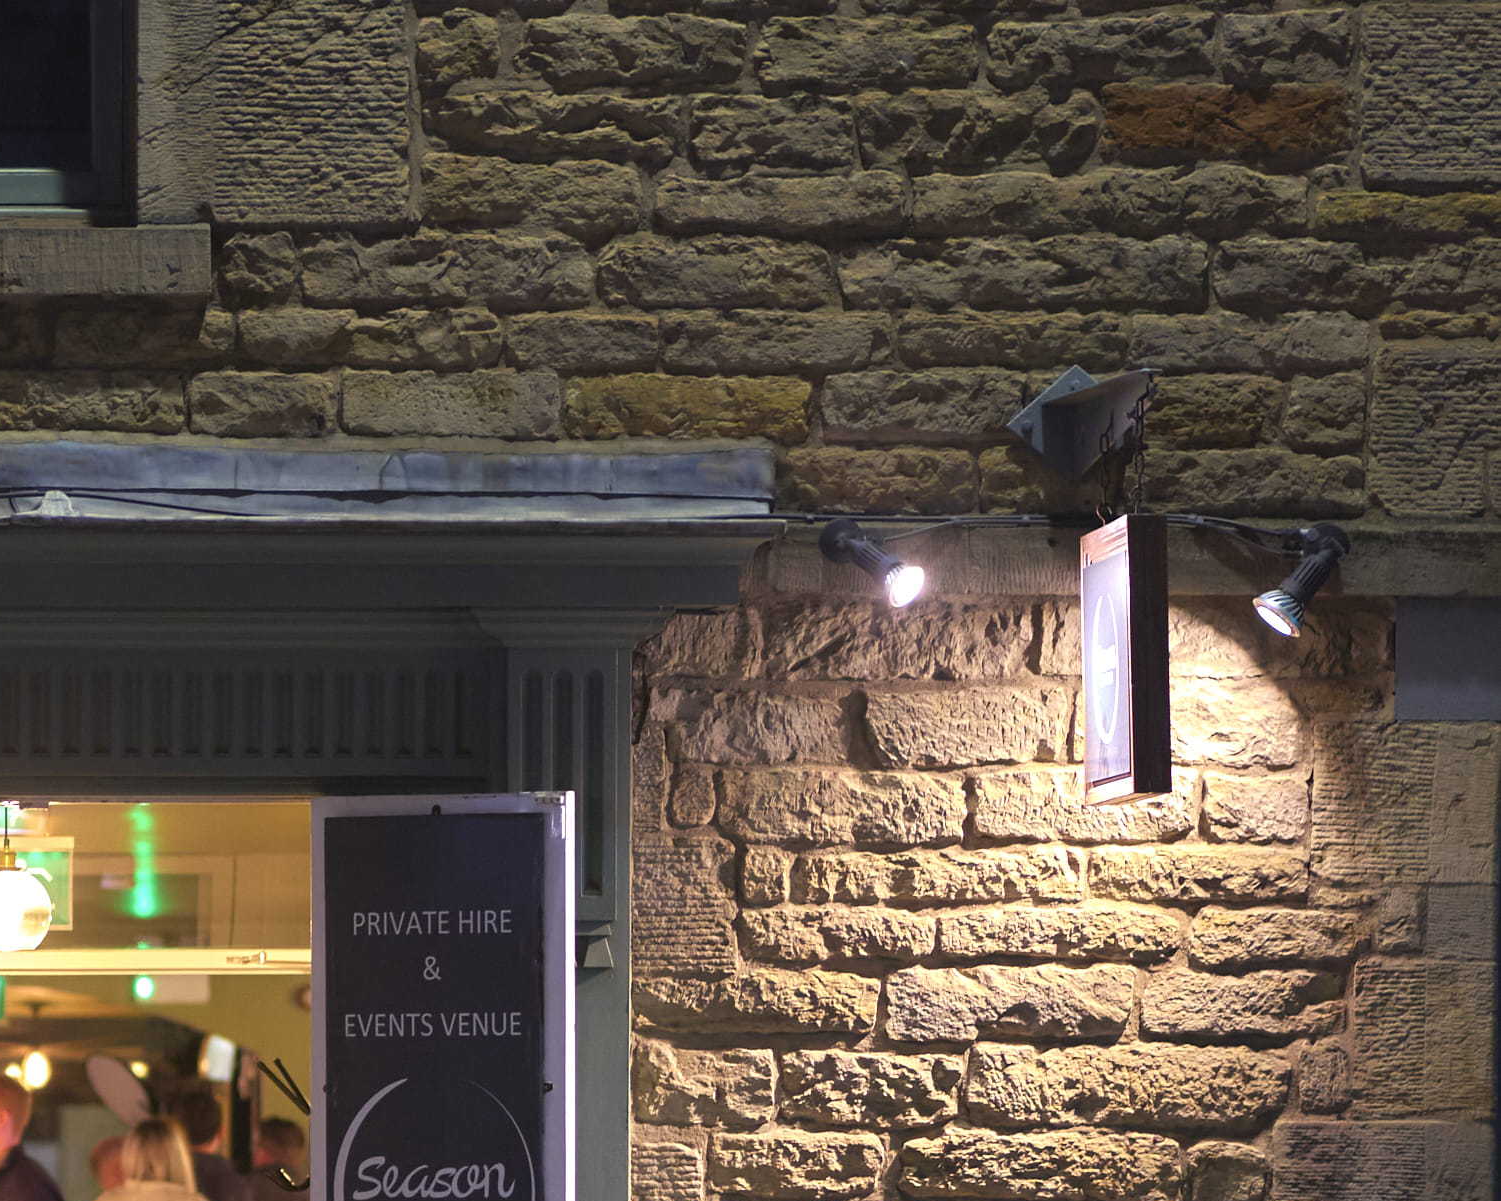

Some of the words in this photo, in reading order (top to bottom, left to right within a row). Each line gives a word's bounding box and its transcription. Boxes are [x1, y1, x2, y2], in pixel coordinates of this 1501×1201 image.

[353, 910, 450, 936] PRIVATE
[458, 909, 512, 934] HIRE
[422, 955, 442, 981] &
[344, 1012, 434, 1038] EVENTS
[440, 1011, 522, 1037] VENUE
[352, 1155, 516, 1201] Season
